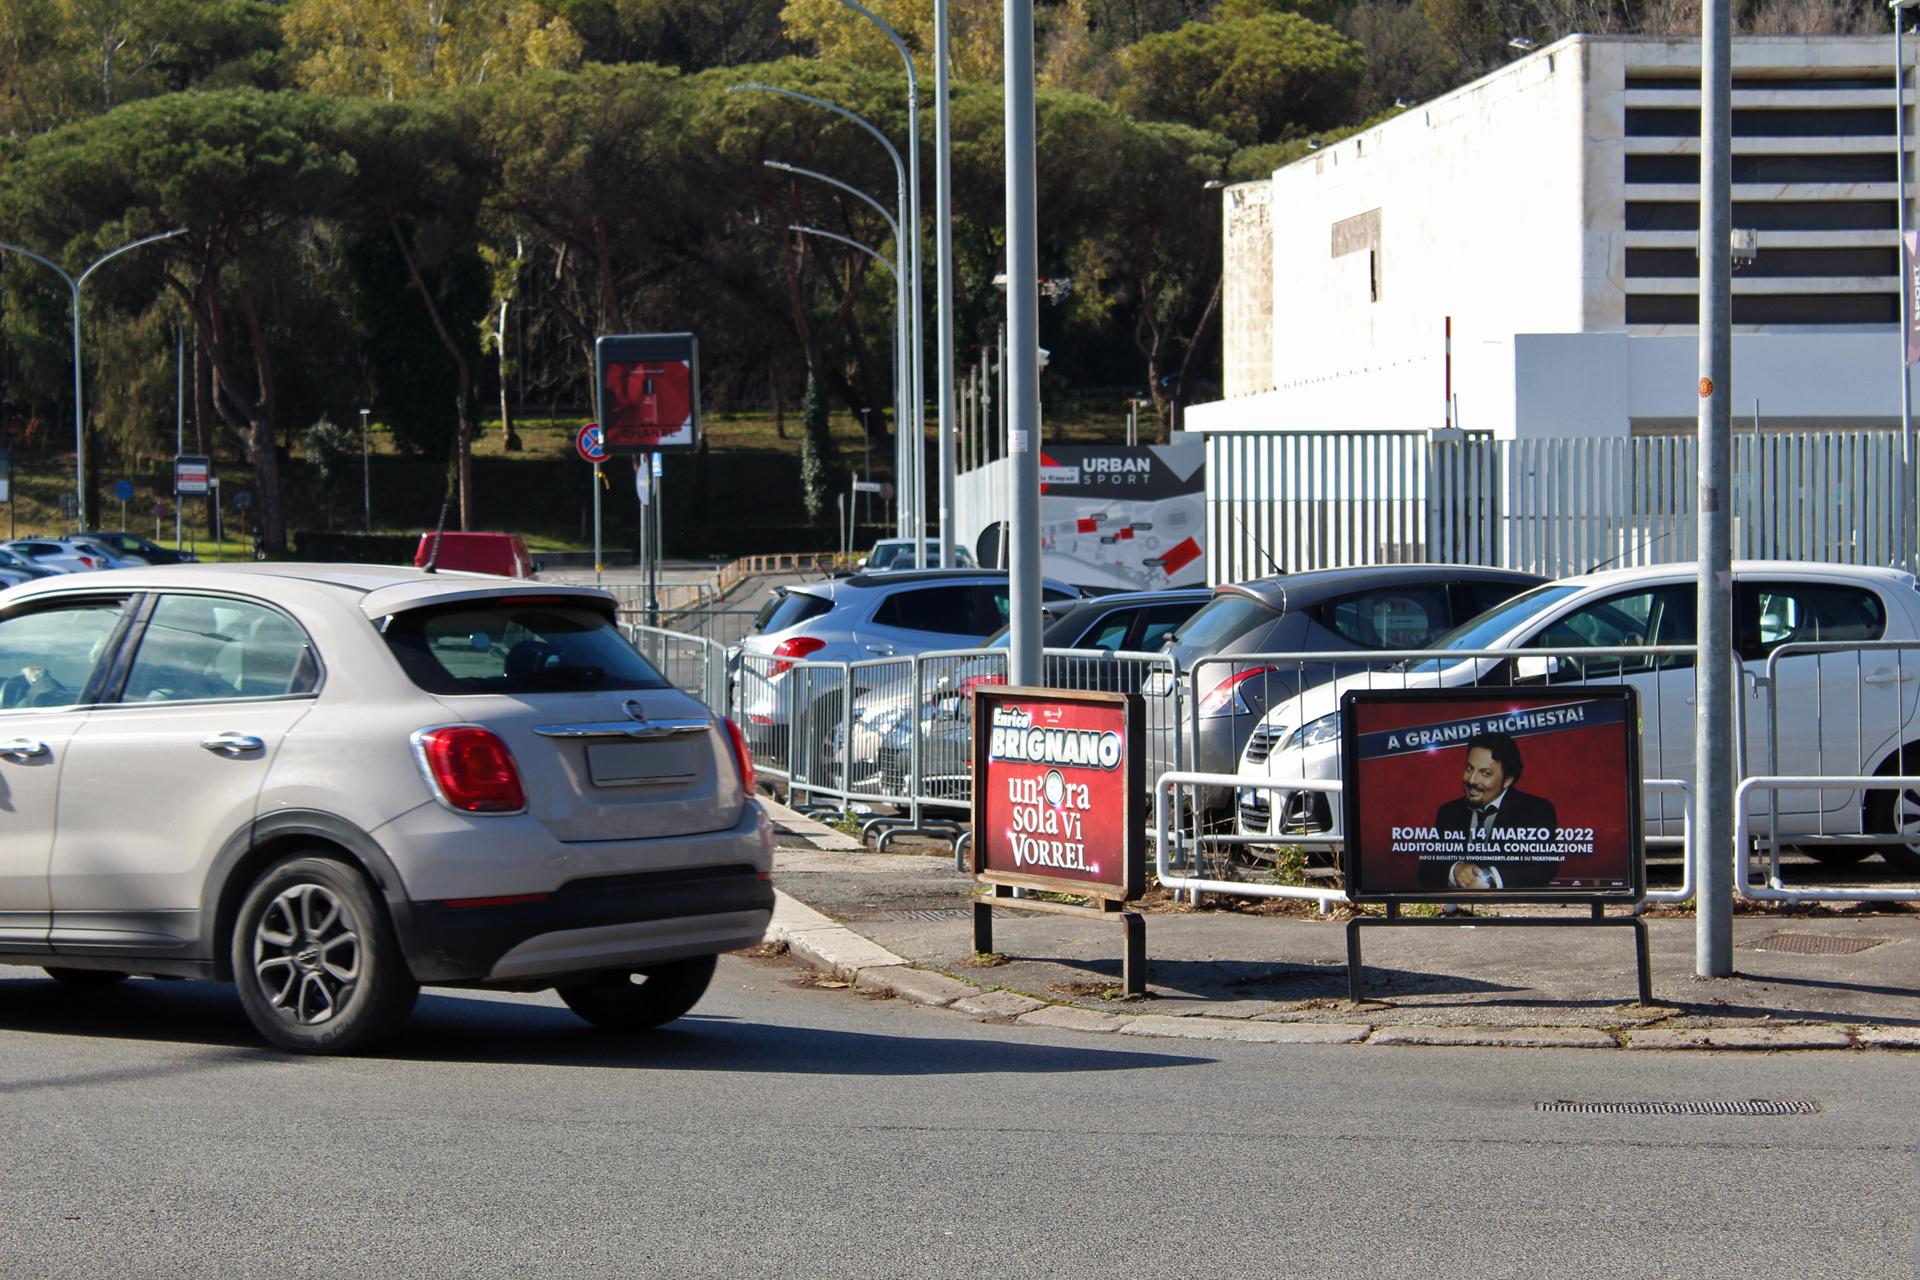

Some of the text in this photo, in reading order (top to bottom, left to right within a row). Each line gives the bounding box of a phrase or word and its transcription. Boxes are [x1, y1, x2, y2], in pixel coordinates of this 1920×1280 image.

[1083, 458, 1150, 473] URBAN
[1083, 475, 1150, 485] SPORT
[993, 707, 1029, 728] Enrico
[1387, 706, 1585, 751] A GRANDE RICHIESTA!
[991, 727, 1121, 768] BRIGNANO
[1012, 796, 1058, 835] sola
[1391, 827, 1594, 841] ROMA DAL 14 MARZO 2022
[1391, 843, 1594, 854] AUDITORIUM DELLA CONCILIAZIONE
